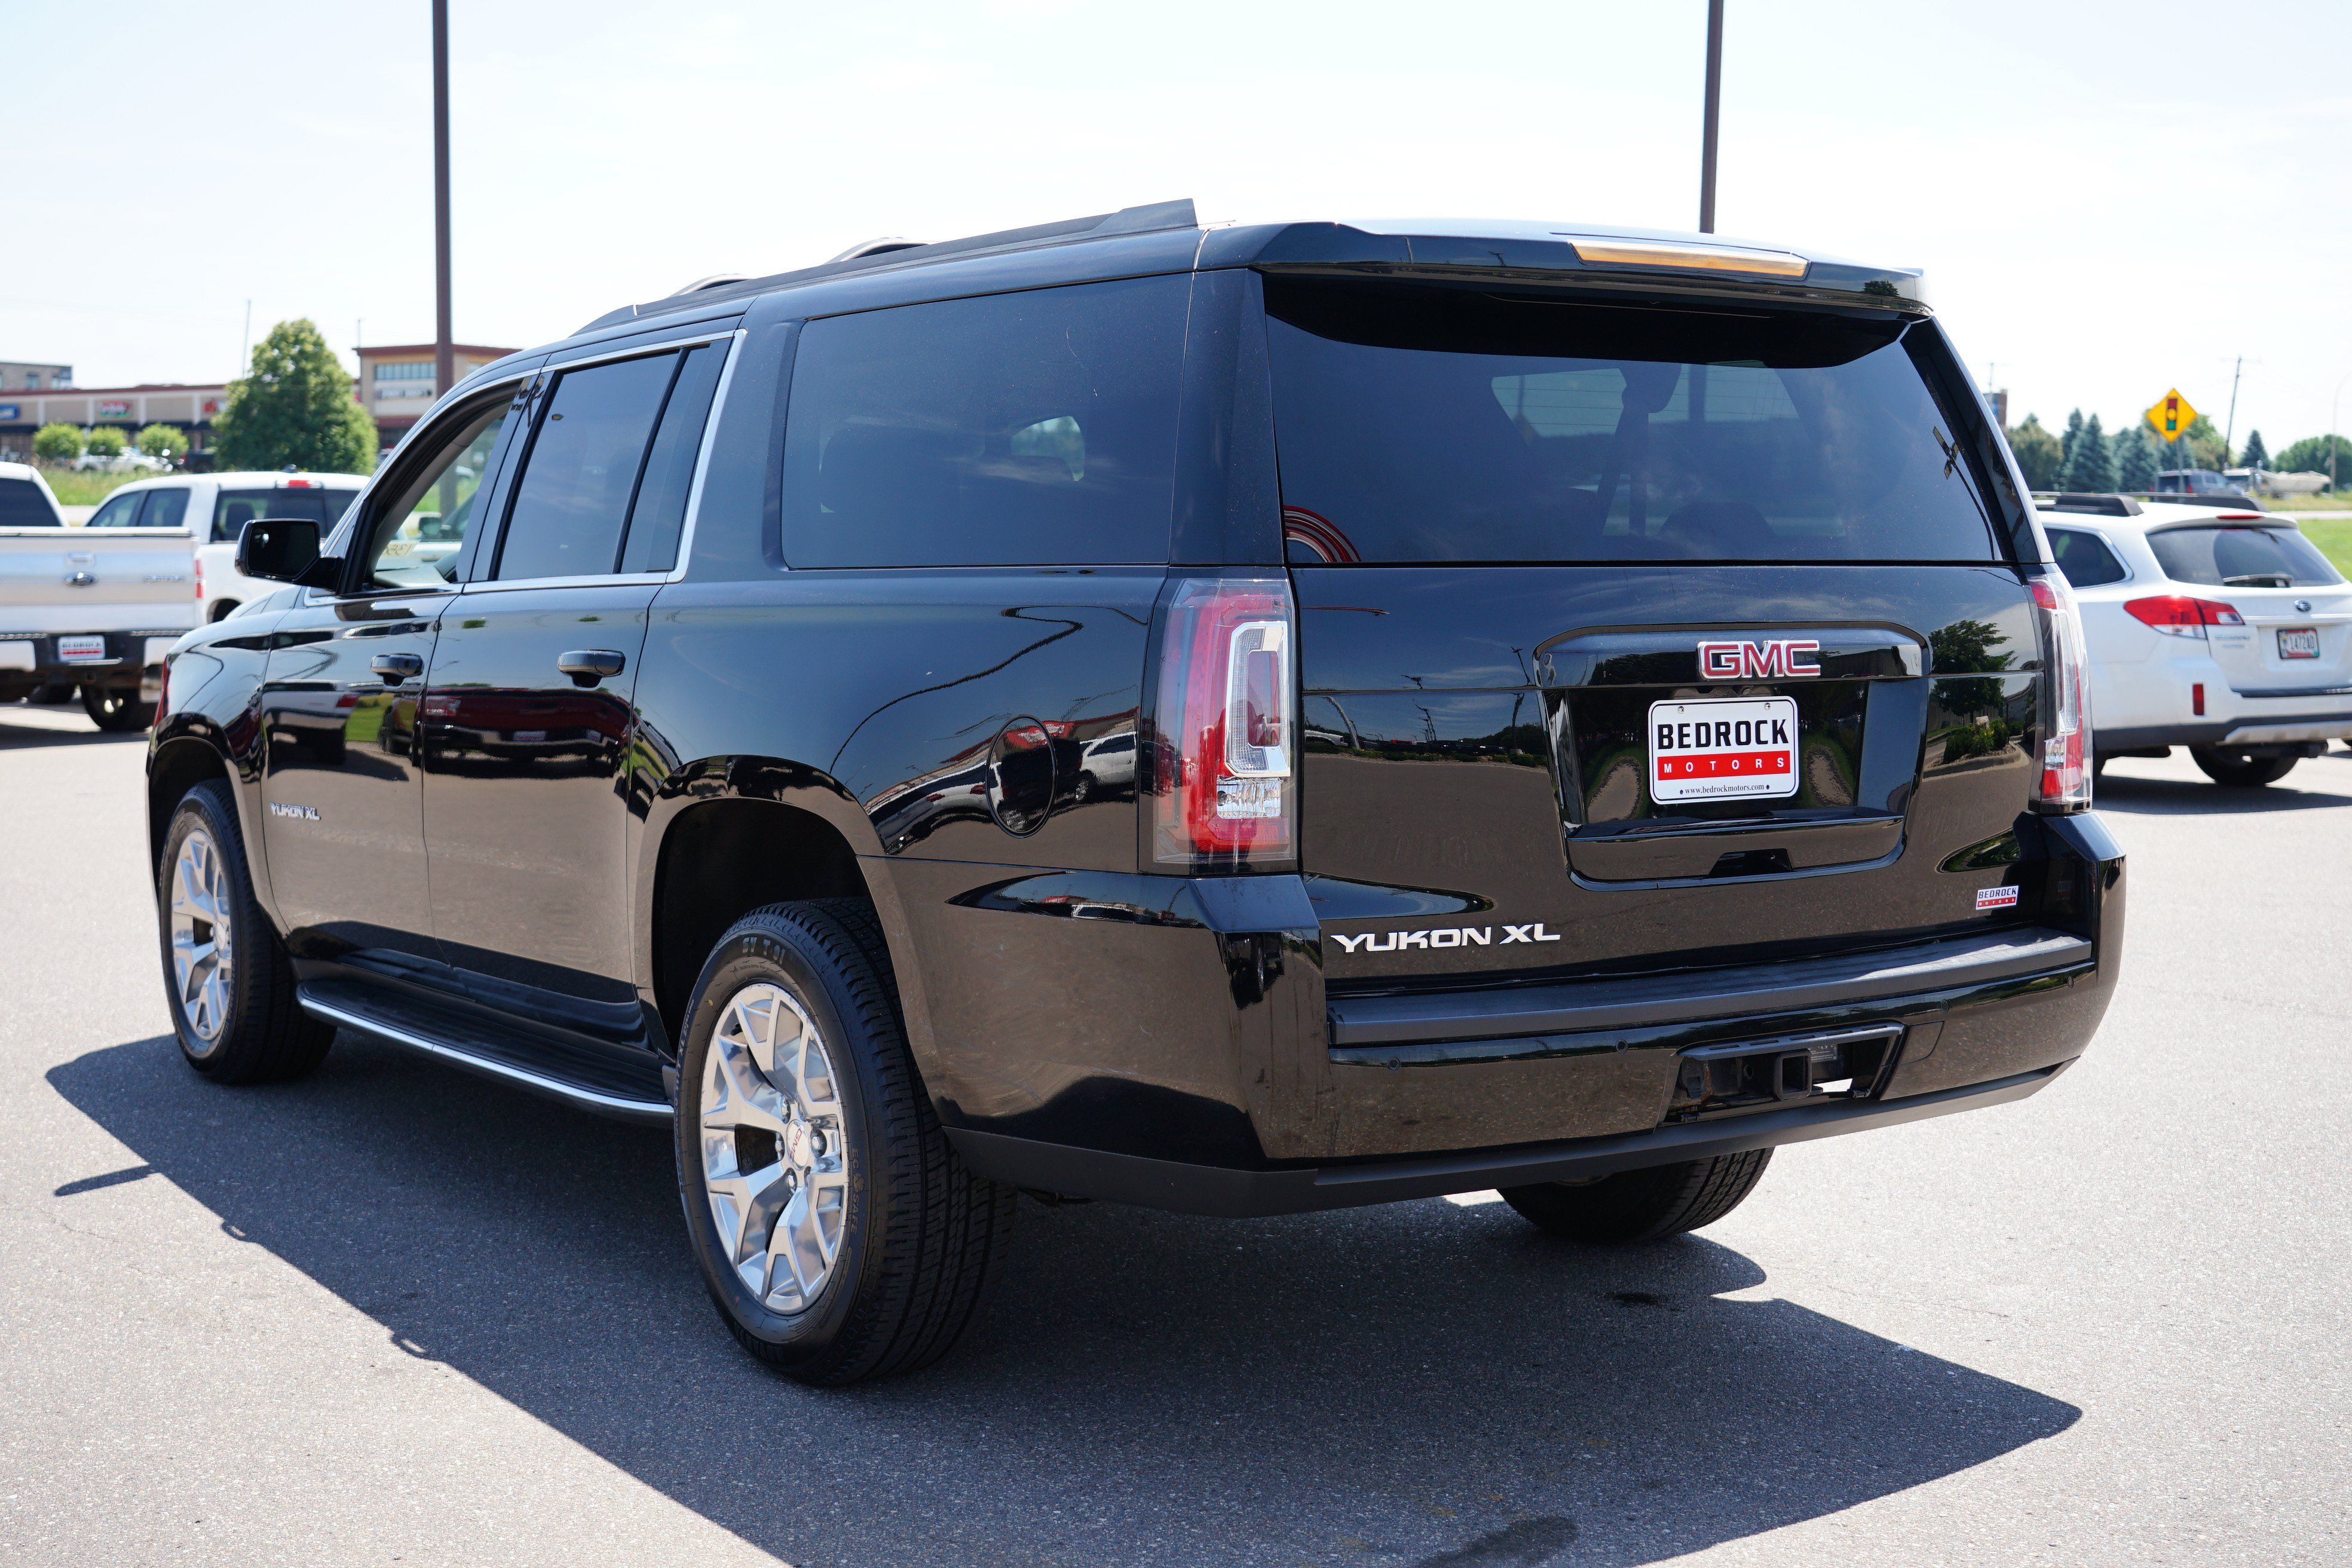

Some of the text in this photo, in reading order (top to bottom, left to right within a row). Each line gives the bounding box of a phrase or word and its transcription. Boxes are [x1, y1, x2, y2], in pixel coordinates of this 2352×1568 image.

[1697, 640, 1821, 679] GMC
[1658, 719, 1789, 749] BEDROCK
[1664, 757, 1784, 773] MOTORS
[1685, 783, 1765, 794] www.bedrockmotors.com
[270, 803, 321, 821] YUKON XL
[1979, 887, 2017, 899] BEDROCK
[1330, 923, 1561, 953] YUKON XL
